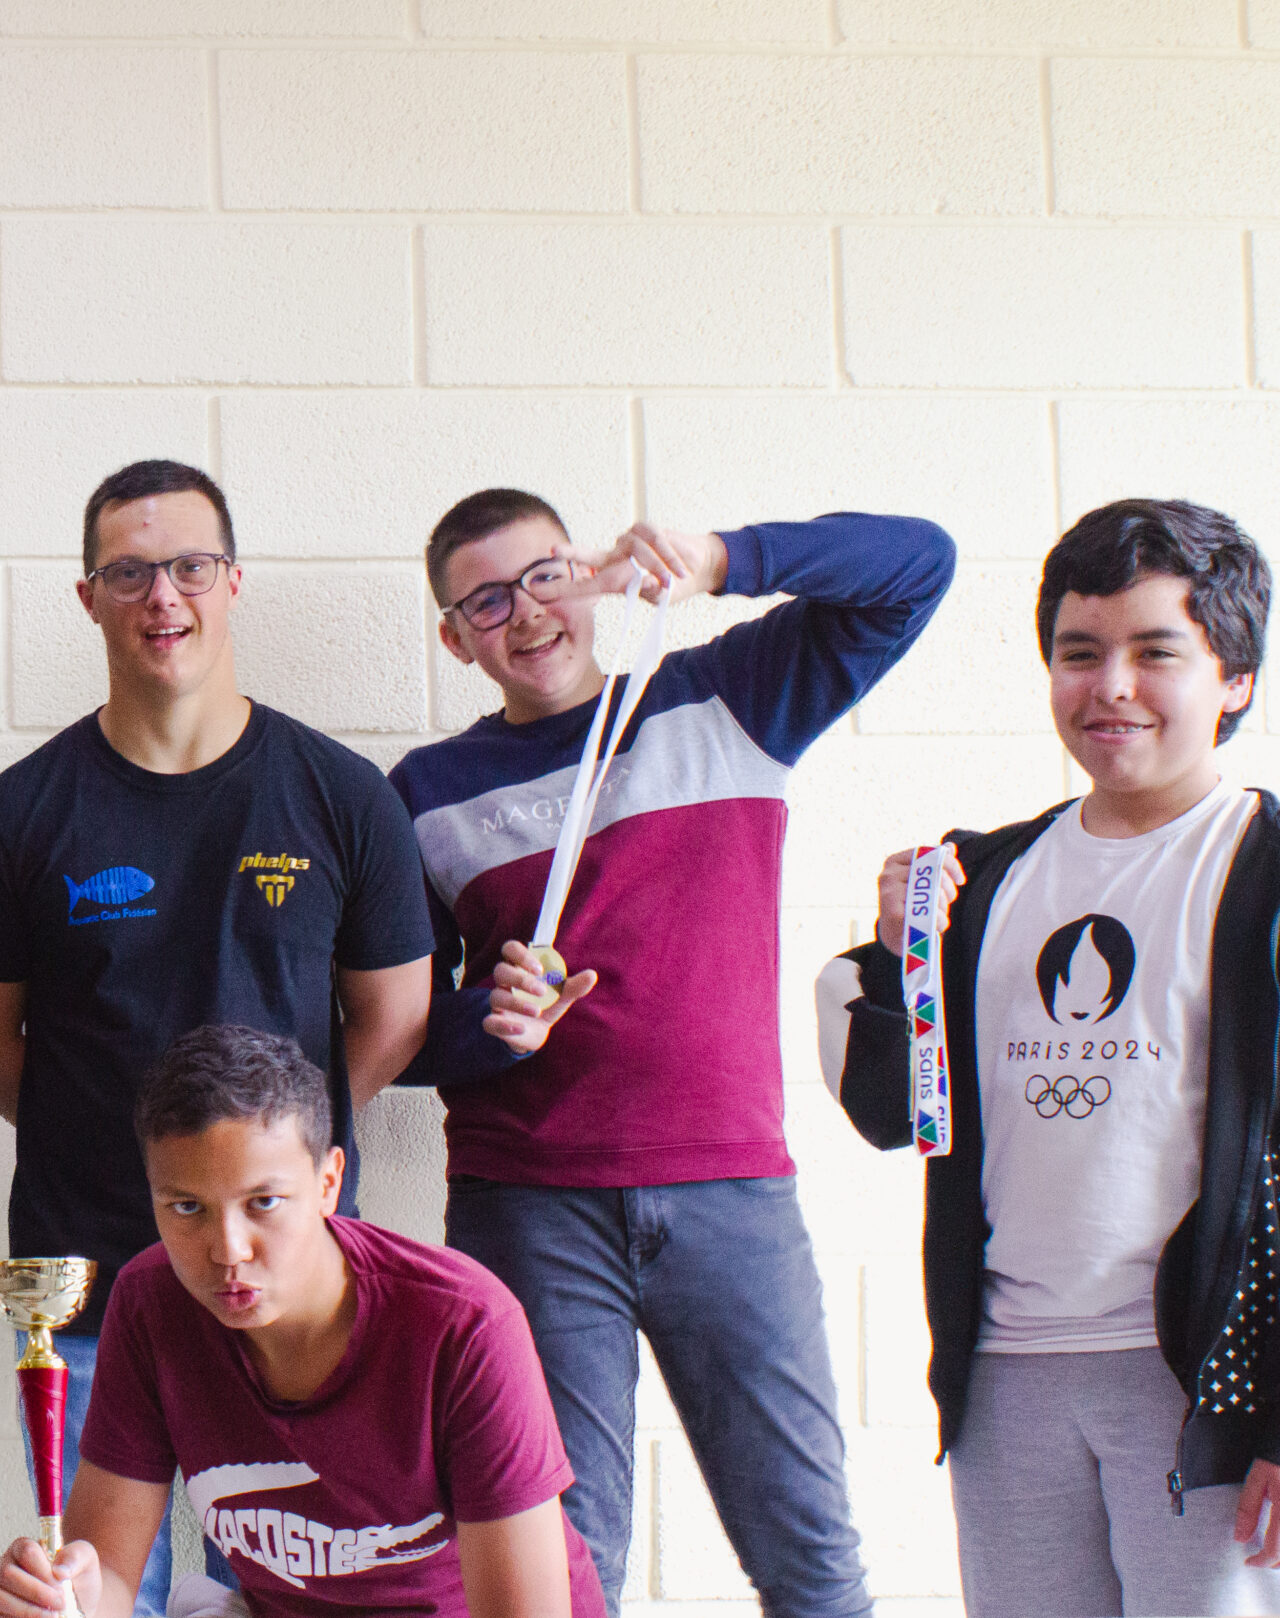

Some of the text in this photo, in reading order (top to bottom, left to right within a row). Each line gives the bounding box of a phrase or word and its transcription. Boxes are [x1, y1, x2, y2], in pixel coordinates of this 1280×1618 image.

[237, 851, 311, 873] phelps
[912, 865, 933, 916] SUDS
[100, 910, 120, 920] Club
[1008, 1039, 1160, 1061] PARIS 2024
[919, 1046, 933, 1100] SUDS
[205, 1507, 357, 1577] LACOSTE
